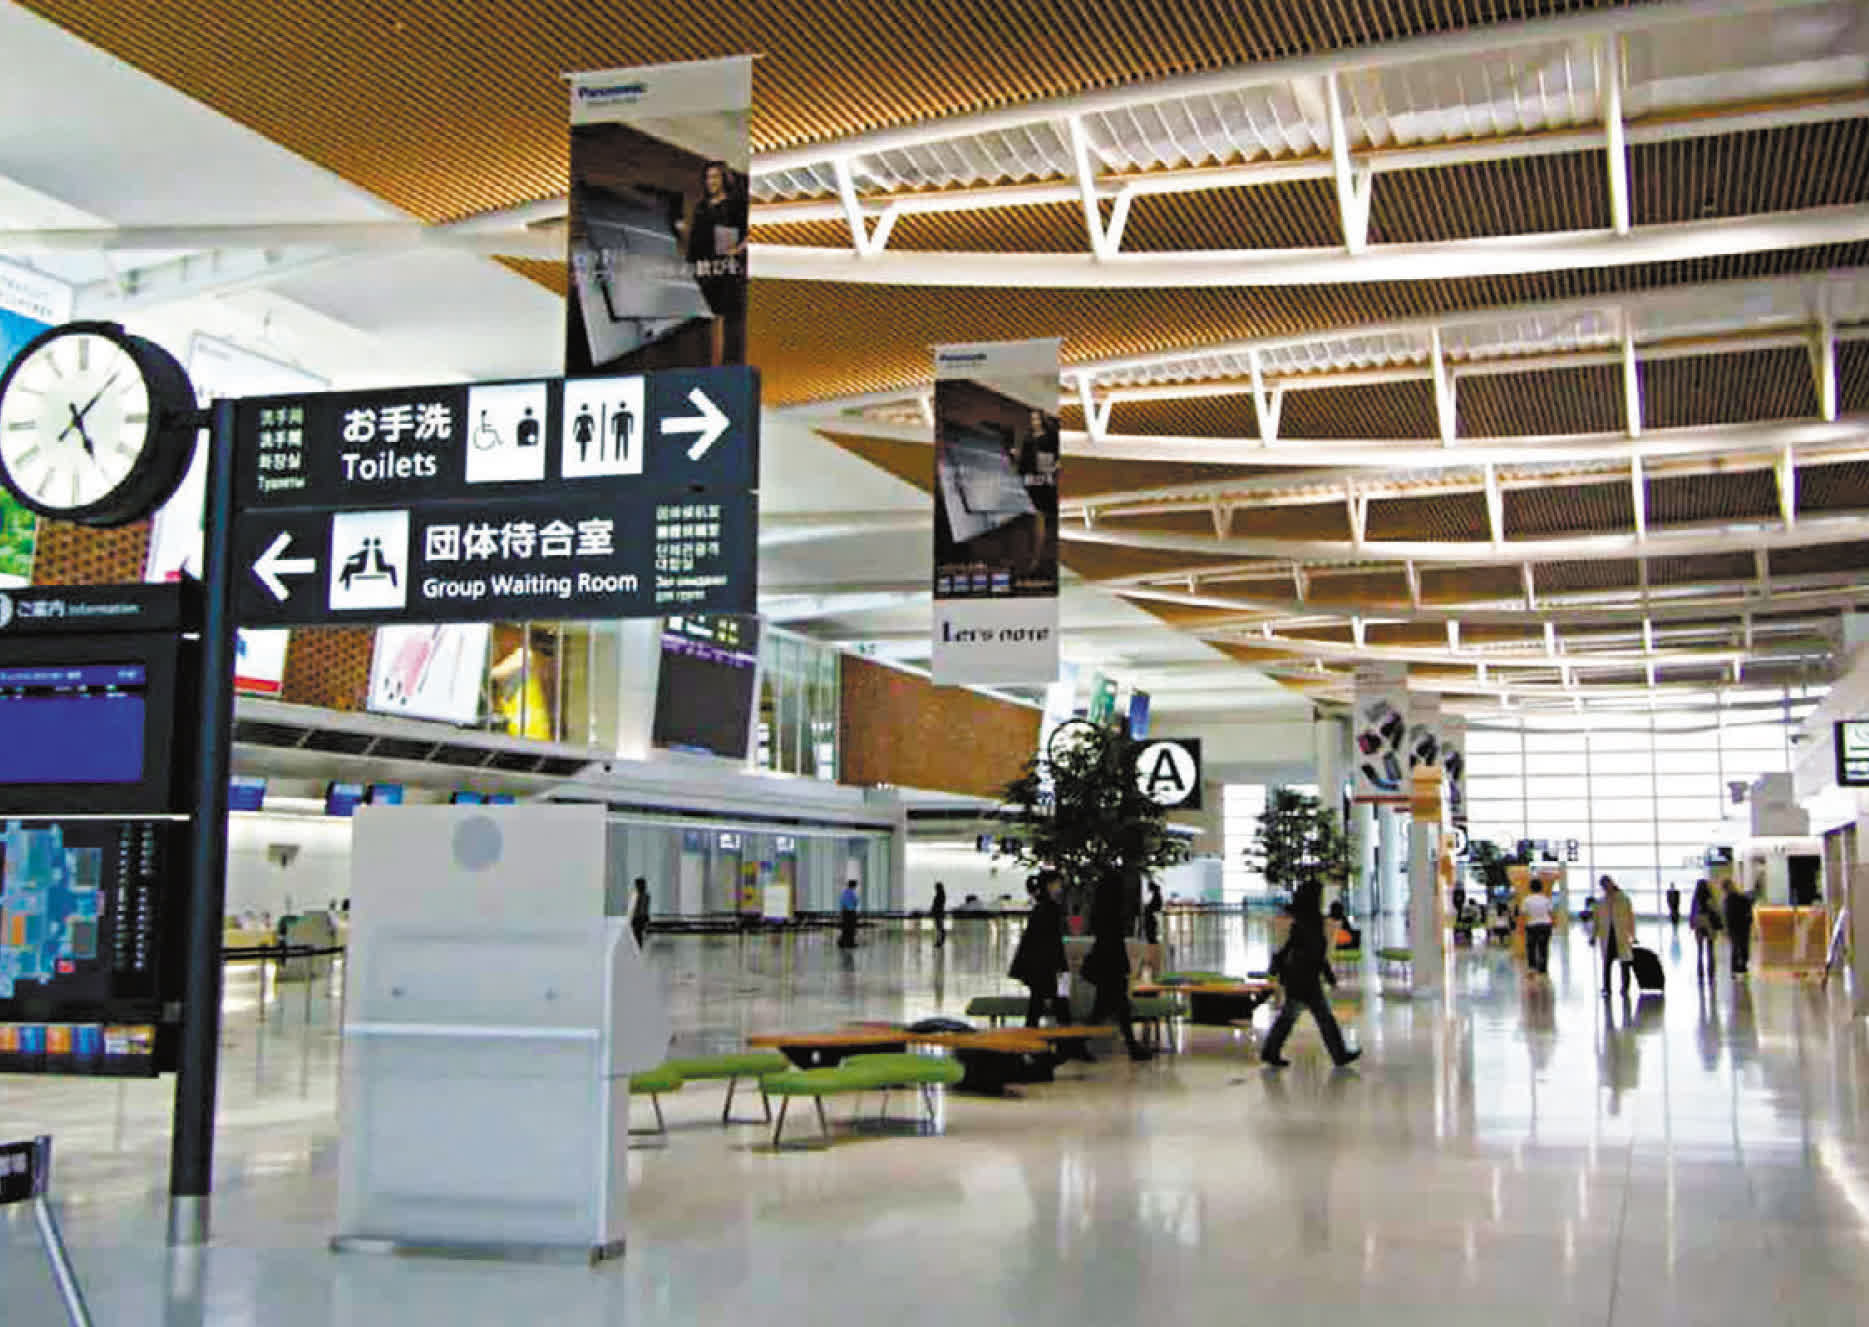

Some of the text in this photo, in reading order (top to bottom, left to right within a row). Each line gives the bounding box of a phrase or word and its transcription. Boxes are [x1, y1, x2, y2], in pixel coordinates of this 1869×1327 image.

[343, 403, 452, 443] お手洗
[341, 449, 438, 480] Toilets
[424, 517, 615, 561] 団体待合室
[422, 577, 486, 600] Group
[490, 573, 572, 599] Waiting
[577, 572, 638, 593] Room
[1146, 747, 1185, 792] A
